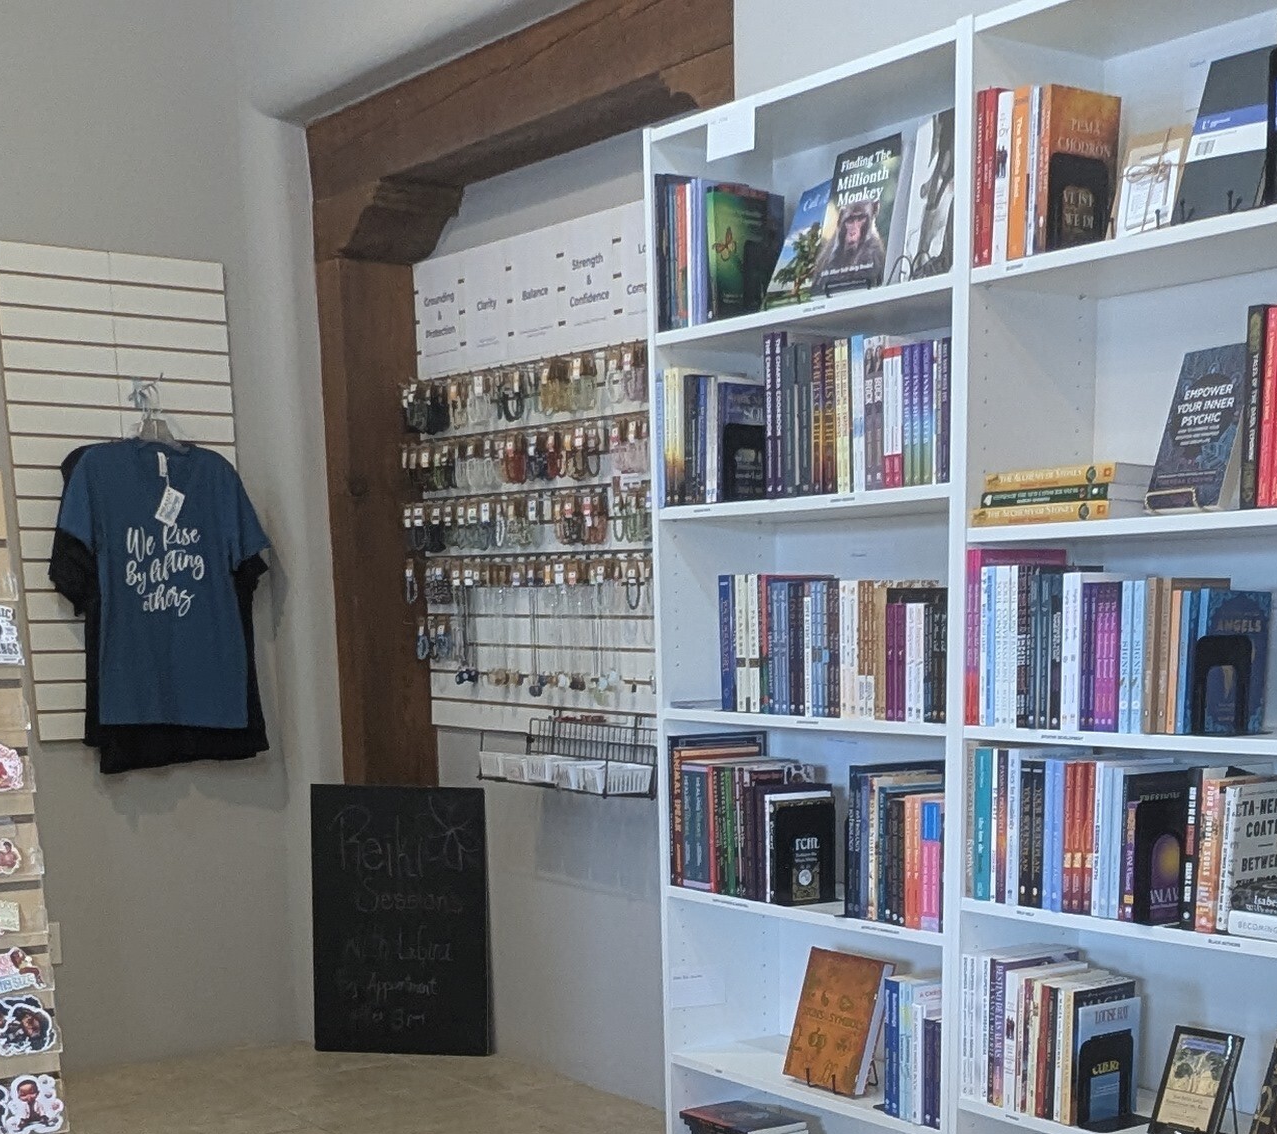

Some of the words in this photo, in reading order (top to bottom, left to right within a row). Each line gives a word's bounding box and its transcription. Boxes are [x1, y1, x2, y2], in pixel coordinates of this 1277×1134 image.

[841, 155, 874, 172] Finding
[875, 149, 892, 162] The
[837, 169, 889, 192] Millionth
[836, 186, 884, 208] Monkey
[572, 253, 604, 270] Strength
[424, 292, 454, 308] Grounding
[522, 287, 548, 300] Balance
[570, 290, 609, 307] Confidence
[477, 299, 497, 312] Clarity
[426, 326, 456, 338] Protection
[825, 348, 834, 398] WHEELS
[1184, 384, 1234, 400] EMPOWER
[1177, 399, 1203, 414] YOUR
[1206, 398, 1234, 413] INNER
[1180, 412, 1222, 426] PSYCHIC
[126, 525, 155, 562] We
[163, 524, 201, 546] Rise
[125, 561, 147, 594] By
[149, 549, 205, 584] lifting
[143, 583, 195, 617] others
